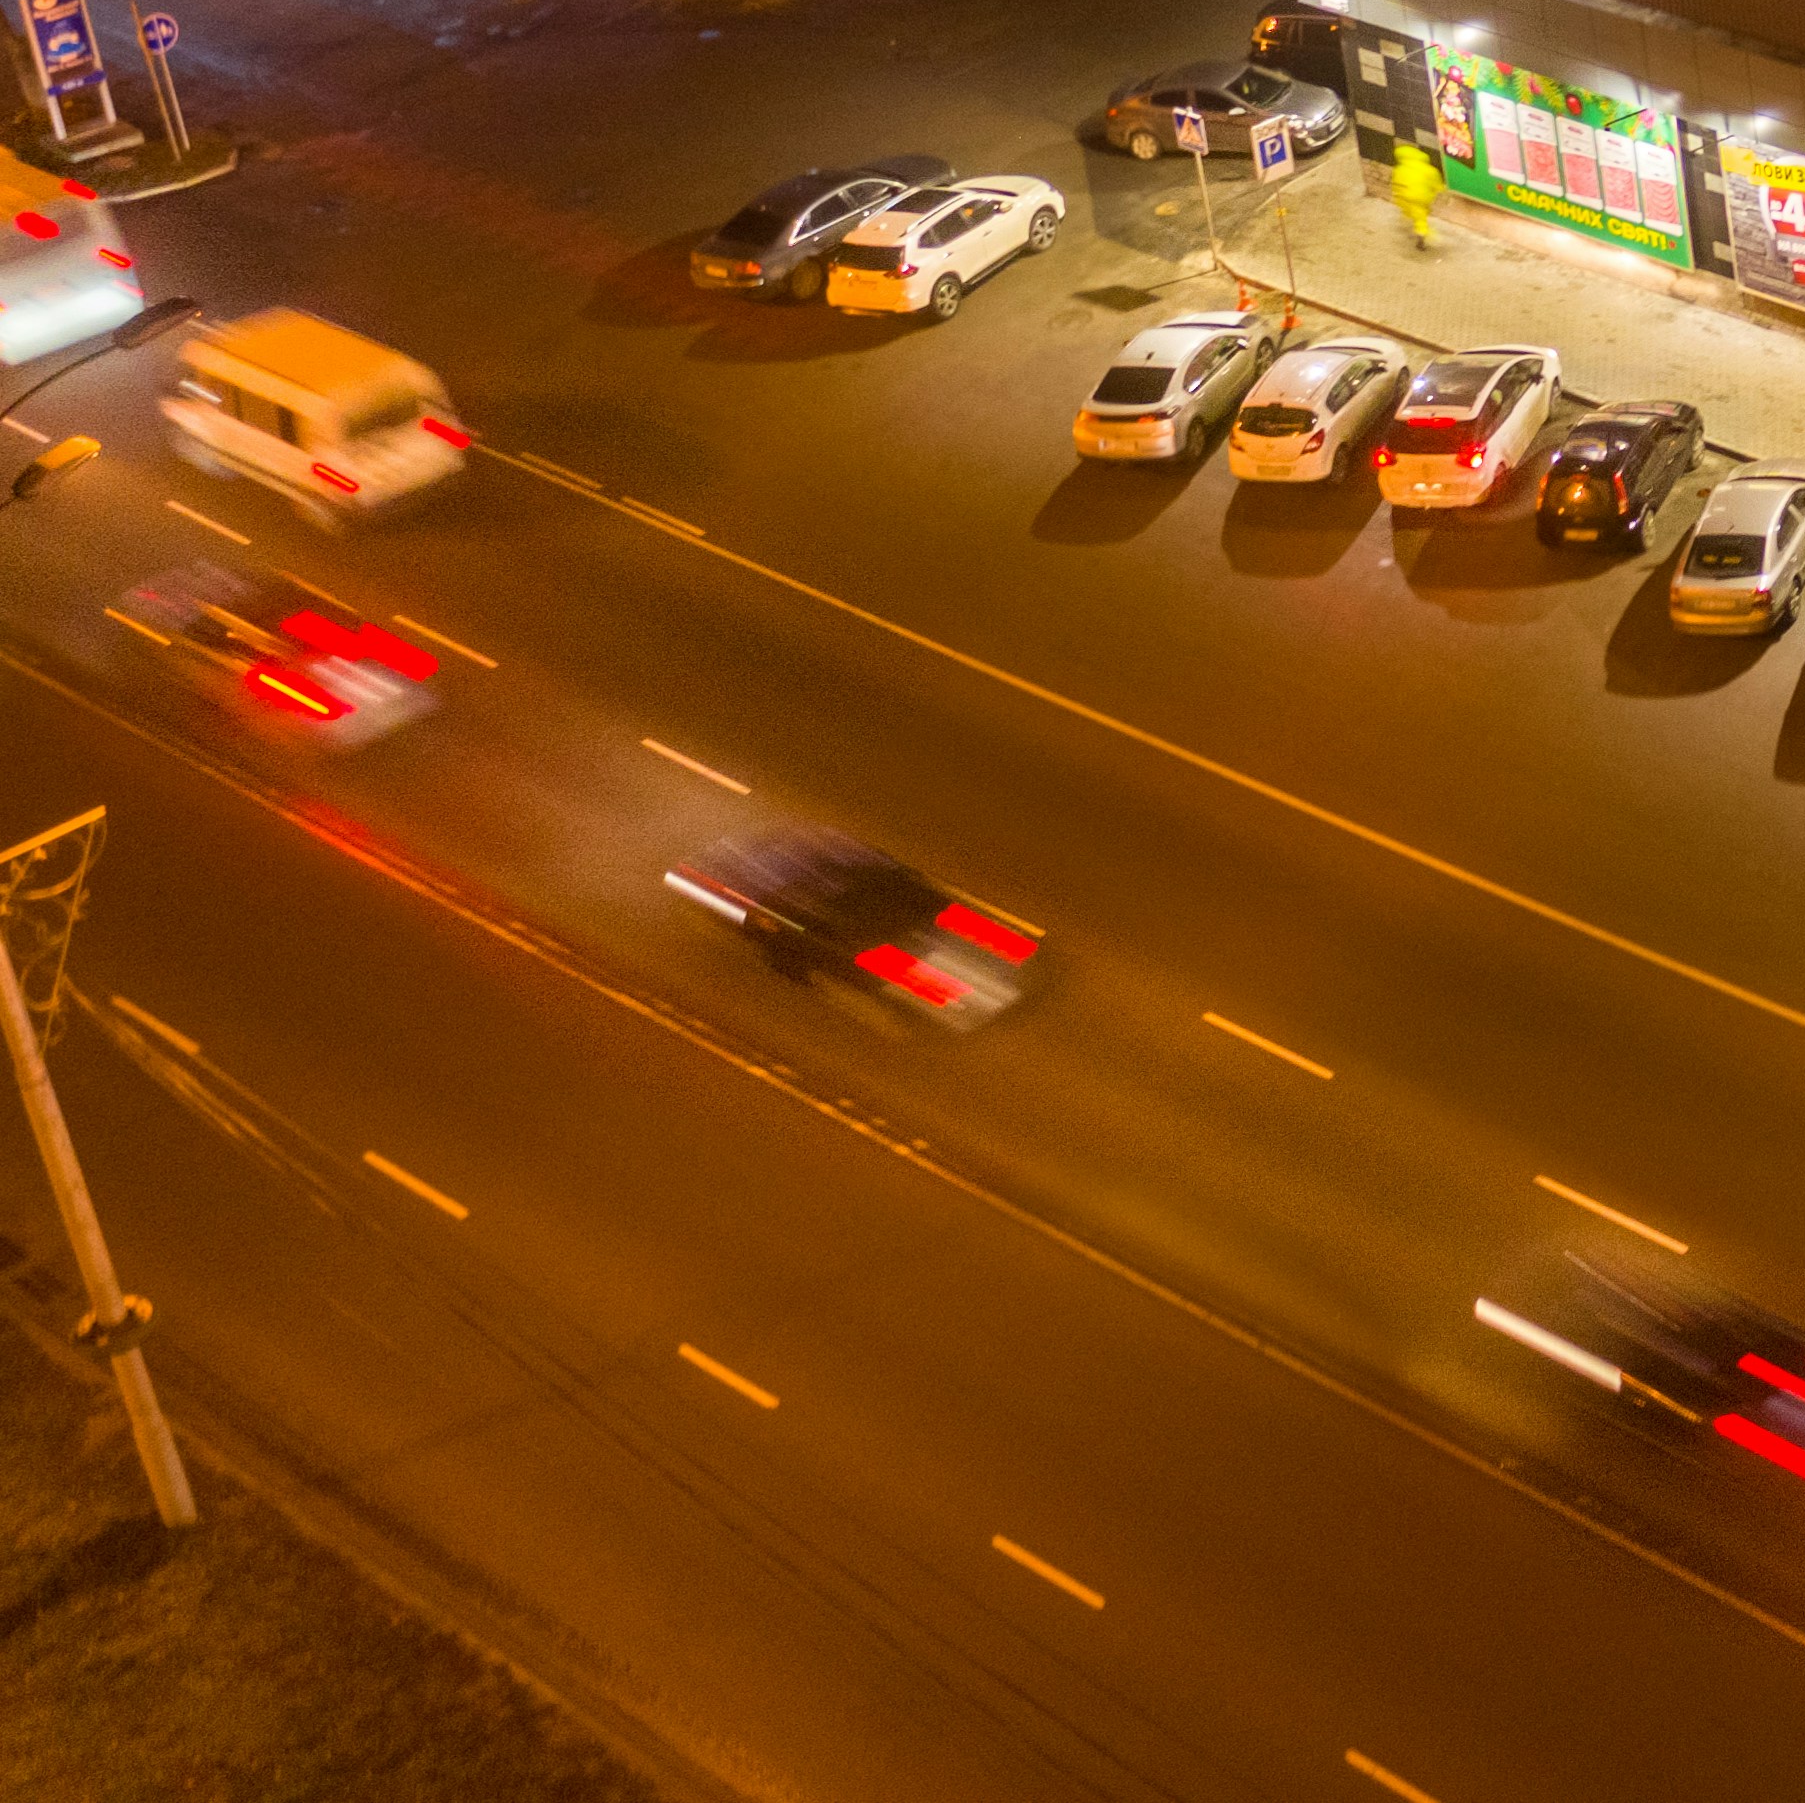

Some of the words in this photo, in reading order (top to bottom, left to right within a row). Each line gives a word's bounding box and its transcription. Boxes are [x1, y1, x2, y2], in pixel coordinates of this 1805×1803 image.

[1264, 137, 1282, 165] P
[1506, 184, 1604, 230] СМАЧНИХ
[1607, 218, 1668, 250] СВЯТ!
